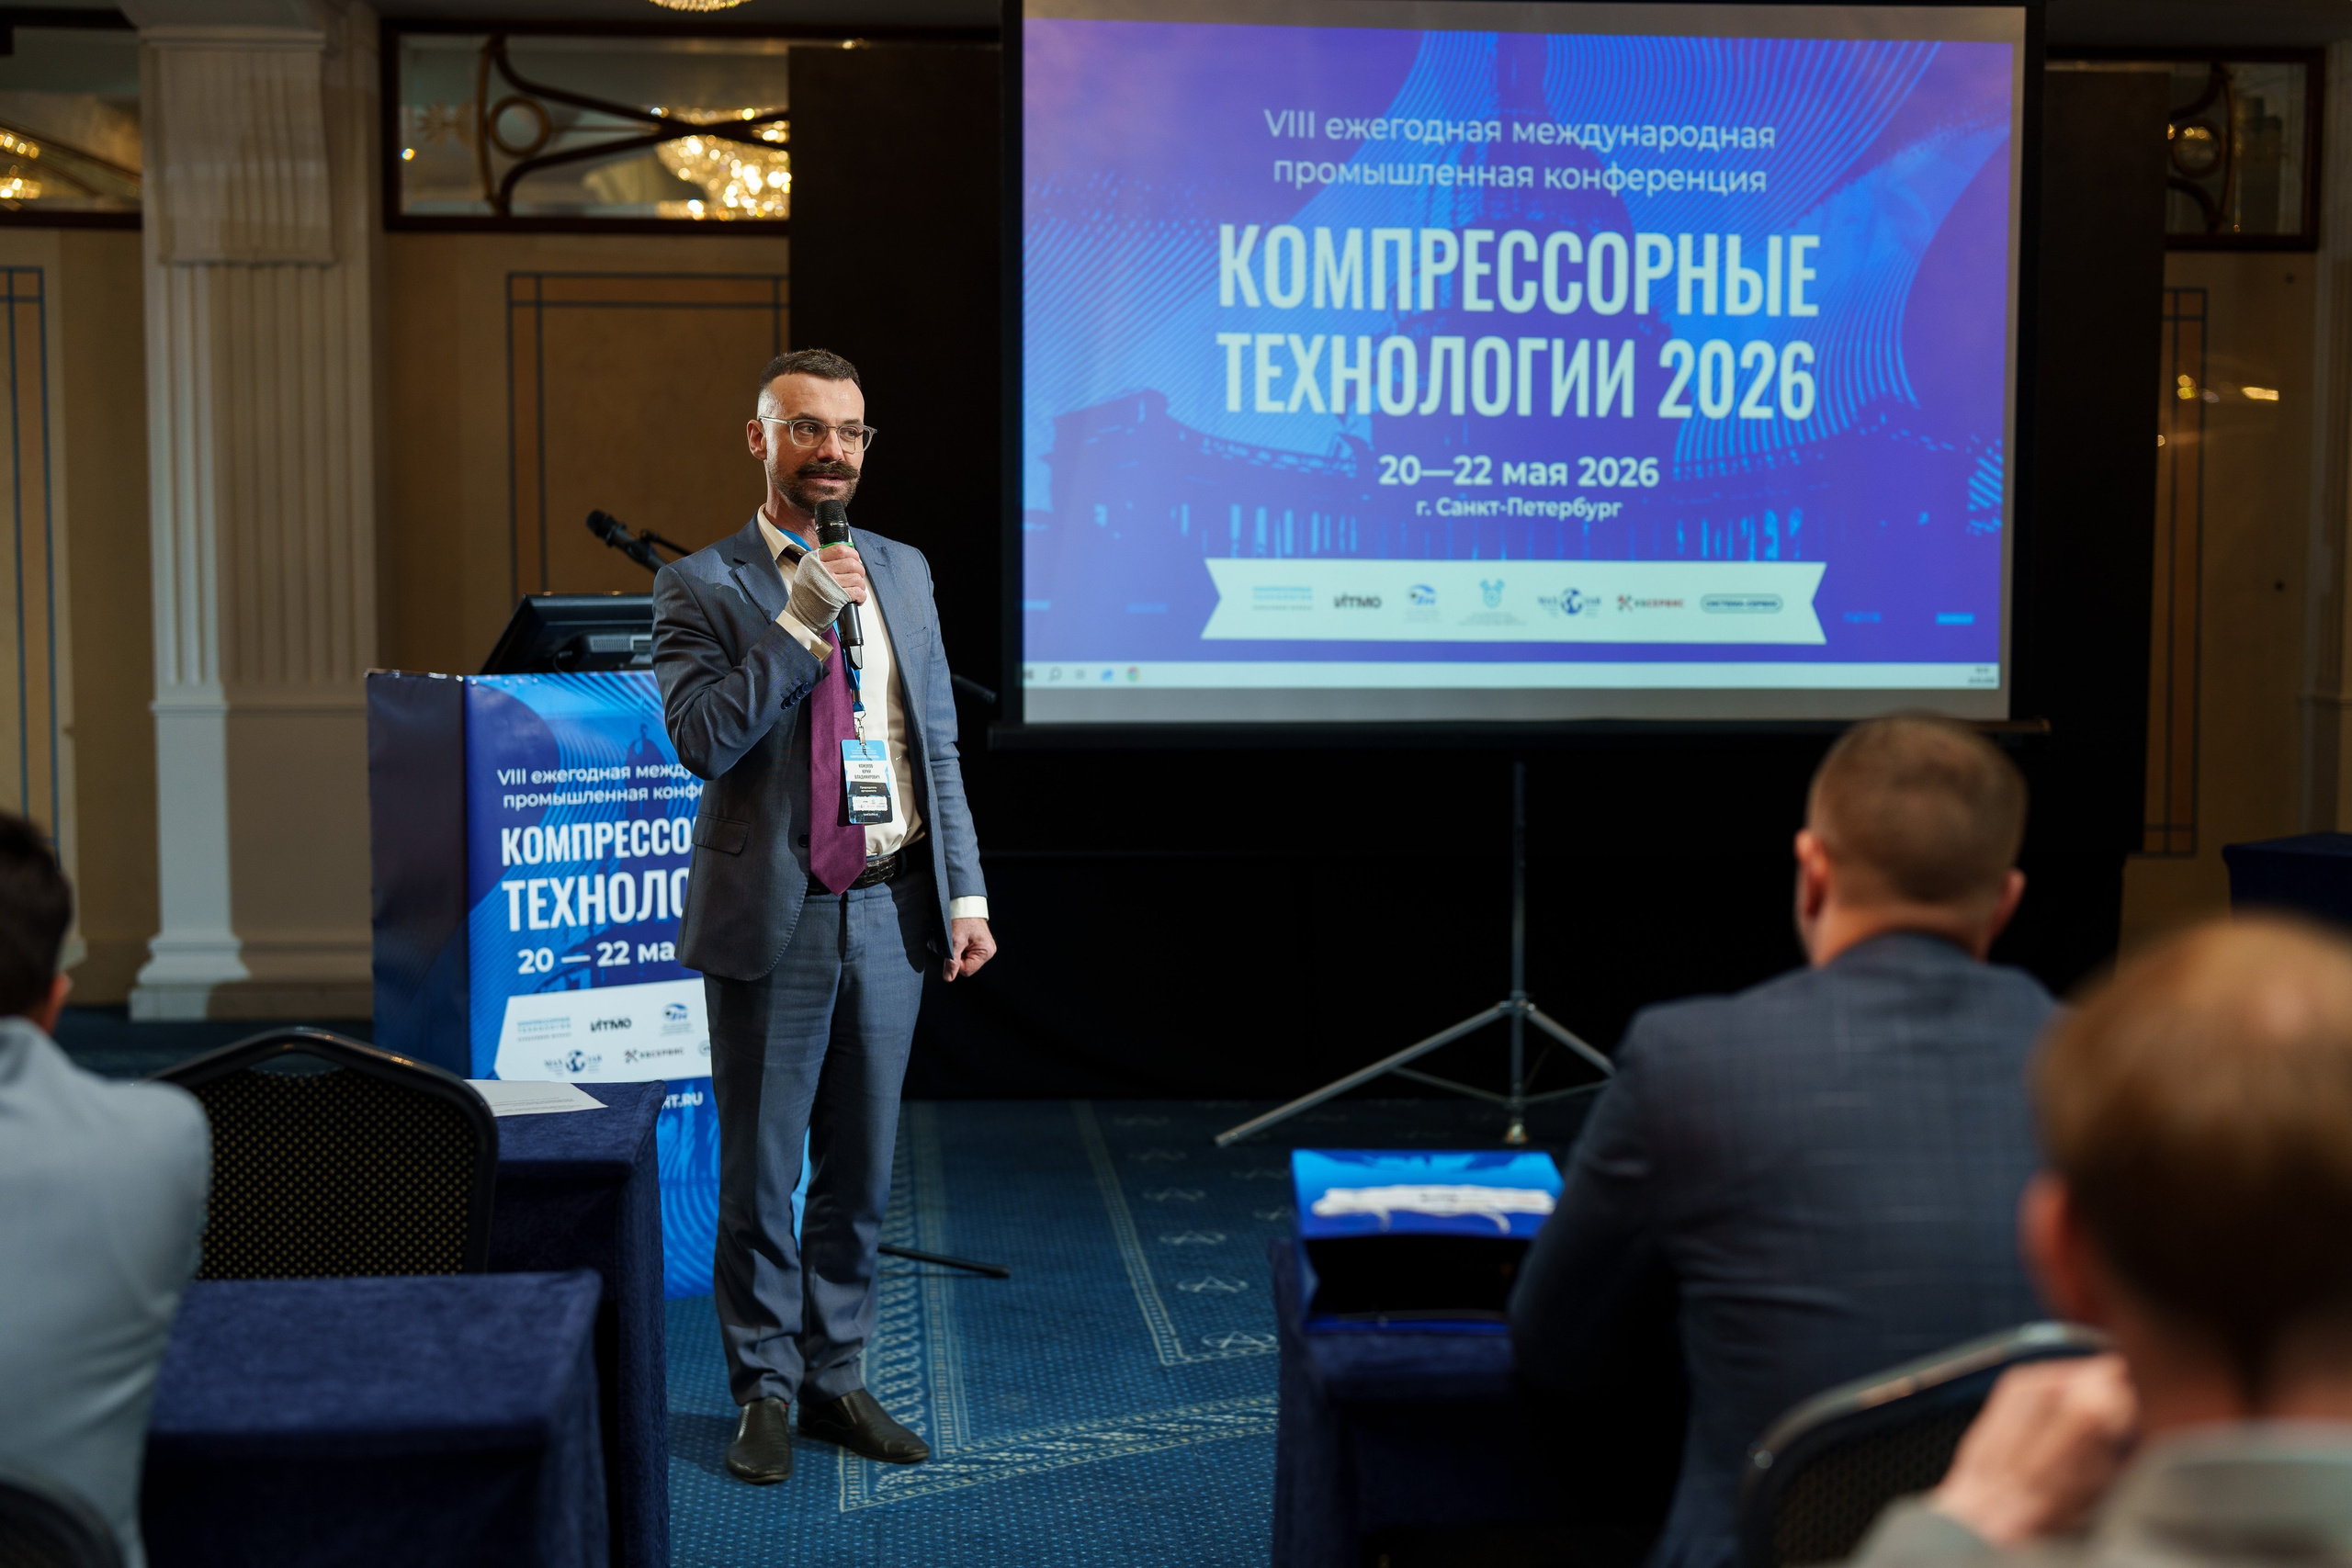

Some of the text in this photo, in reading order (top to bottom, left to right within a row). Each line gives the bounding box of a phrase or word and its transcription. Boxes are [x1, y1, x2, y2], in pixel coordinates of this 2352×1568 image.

[1263, 108, 1776, 153] VIII ежегодная международная
[1273, 160, 1768, 197] промышленная конференция
[1218, 223, 1820, 317] КОМПРЕССОРНЫЕ
[1216, 332, 1816, 421] ТЕХНОЛОГИИ 2026
[1378, 455, 1660, 488] 20—22 мая 2026
[1416, 496, 1623, 522] г. Санкт-Петербург
[496, 768, 526, 785] VIII
[531, 765, 631, 784] ежегодная
[503, 787, 649, 812] промышленная
[501, 816, 696, 867] КОМПРЕССО
[517, 947, 555, 975] 20
[596, 940, 631, 967] 22
[638, 941, 676, 964] ма
